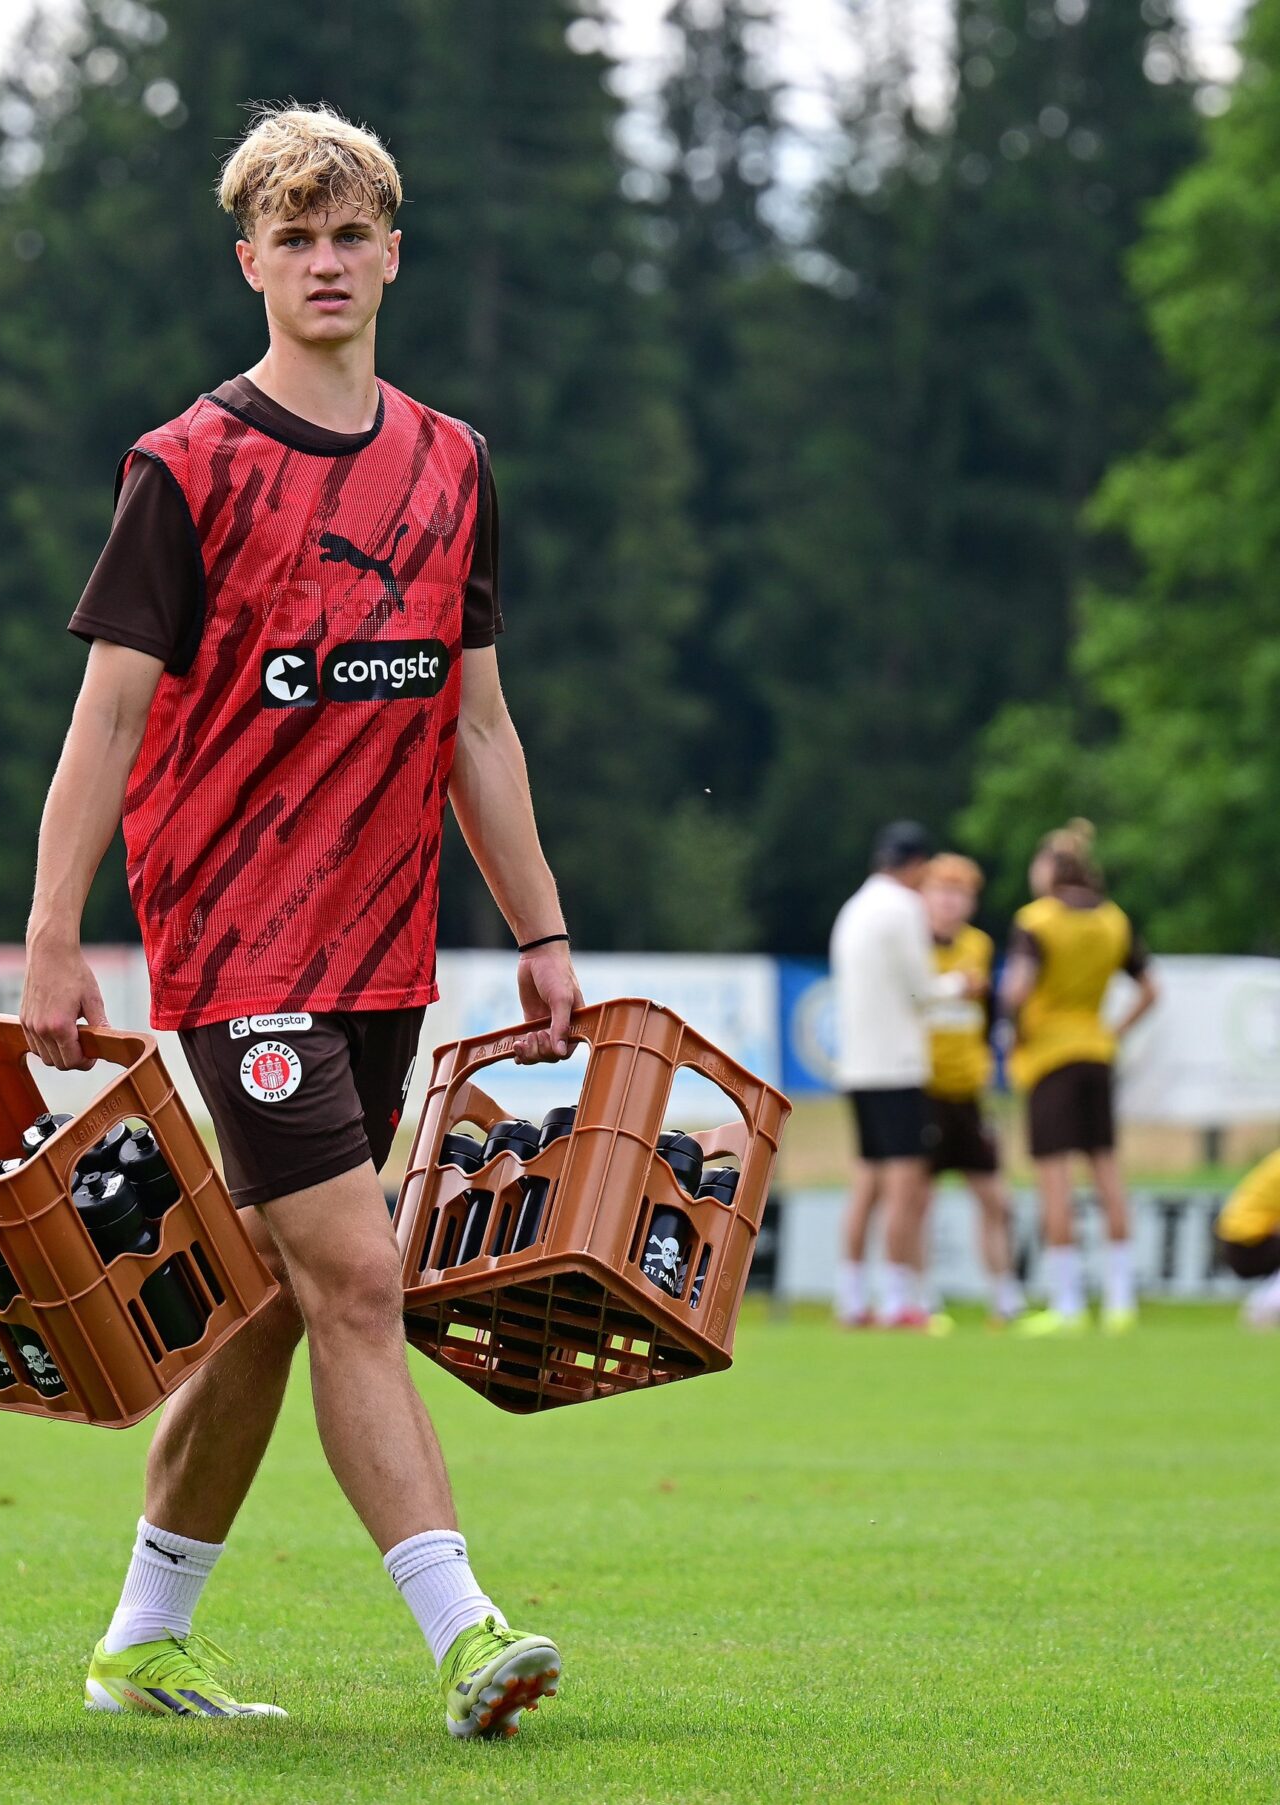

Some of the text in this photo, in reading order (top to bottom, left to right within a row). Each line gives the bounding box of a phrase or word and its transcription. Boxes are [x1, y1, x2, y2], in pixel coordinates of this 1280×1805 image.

[256, 1015, 306, 1028] congstar
[242, 1043, 298, 1074] FC ST. PAULI
[263, 1088, 288, 1100] 1910
[643, 1264, 675, 1288] ST. PAU
[40, 1375, 64, 1385] PAU
